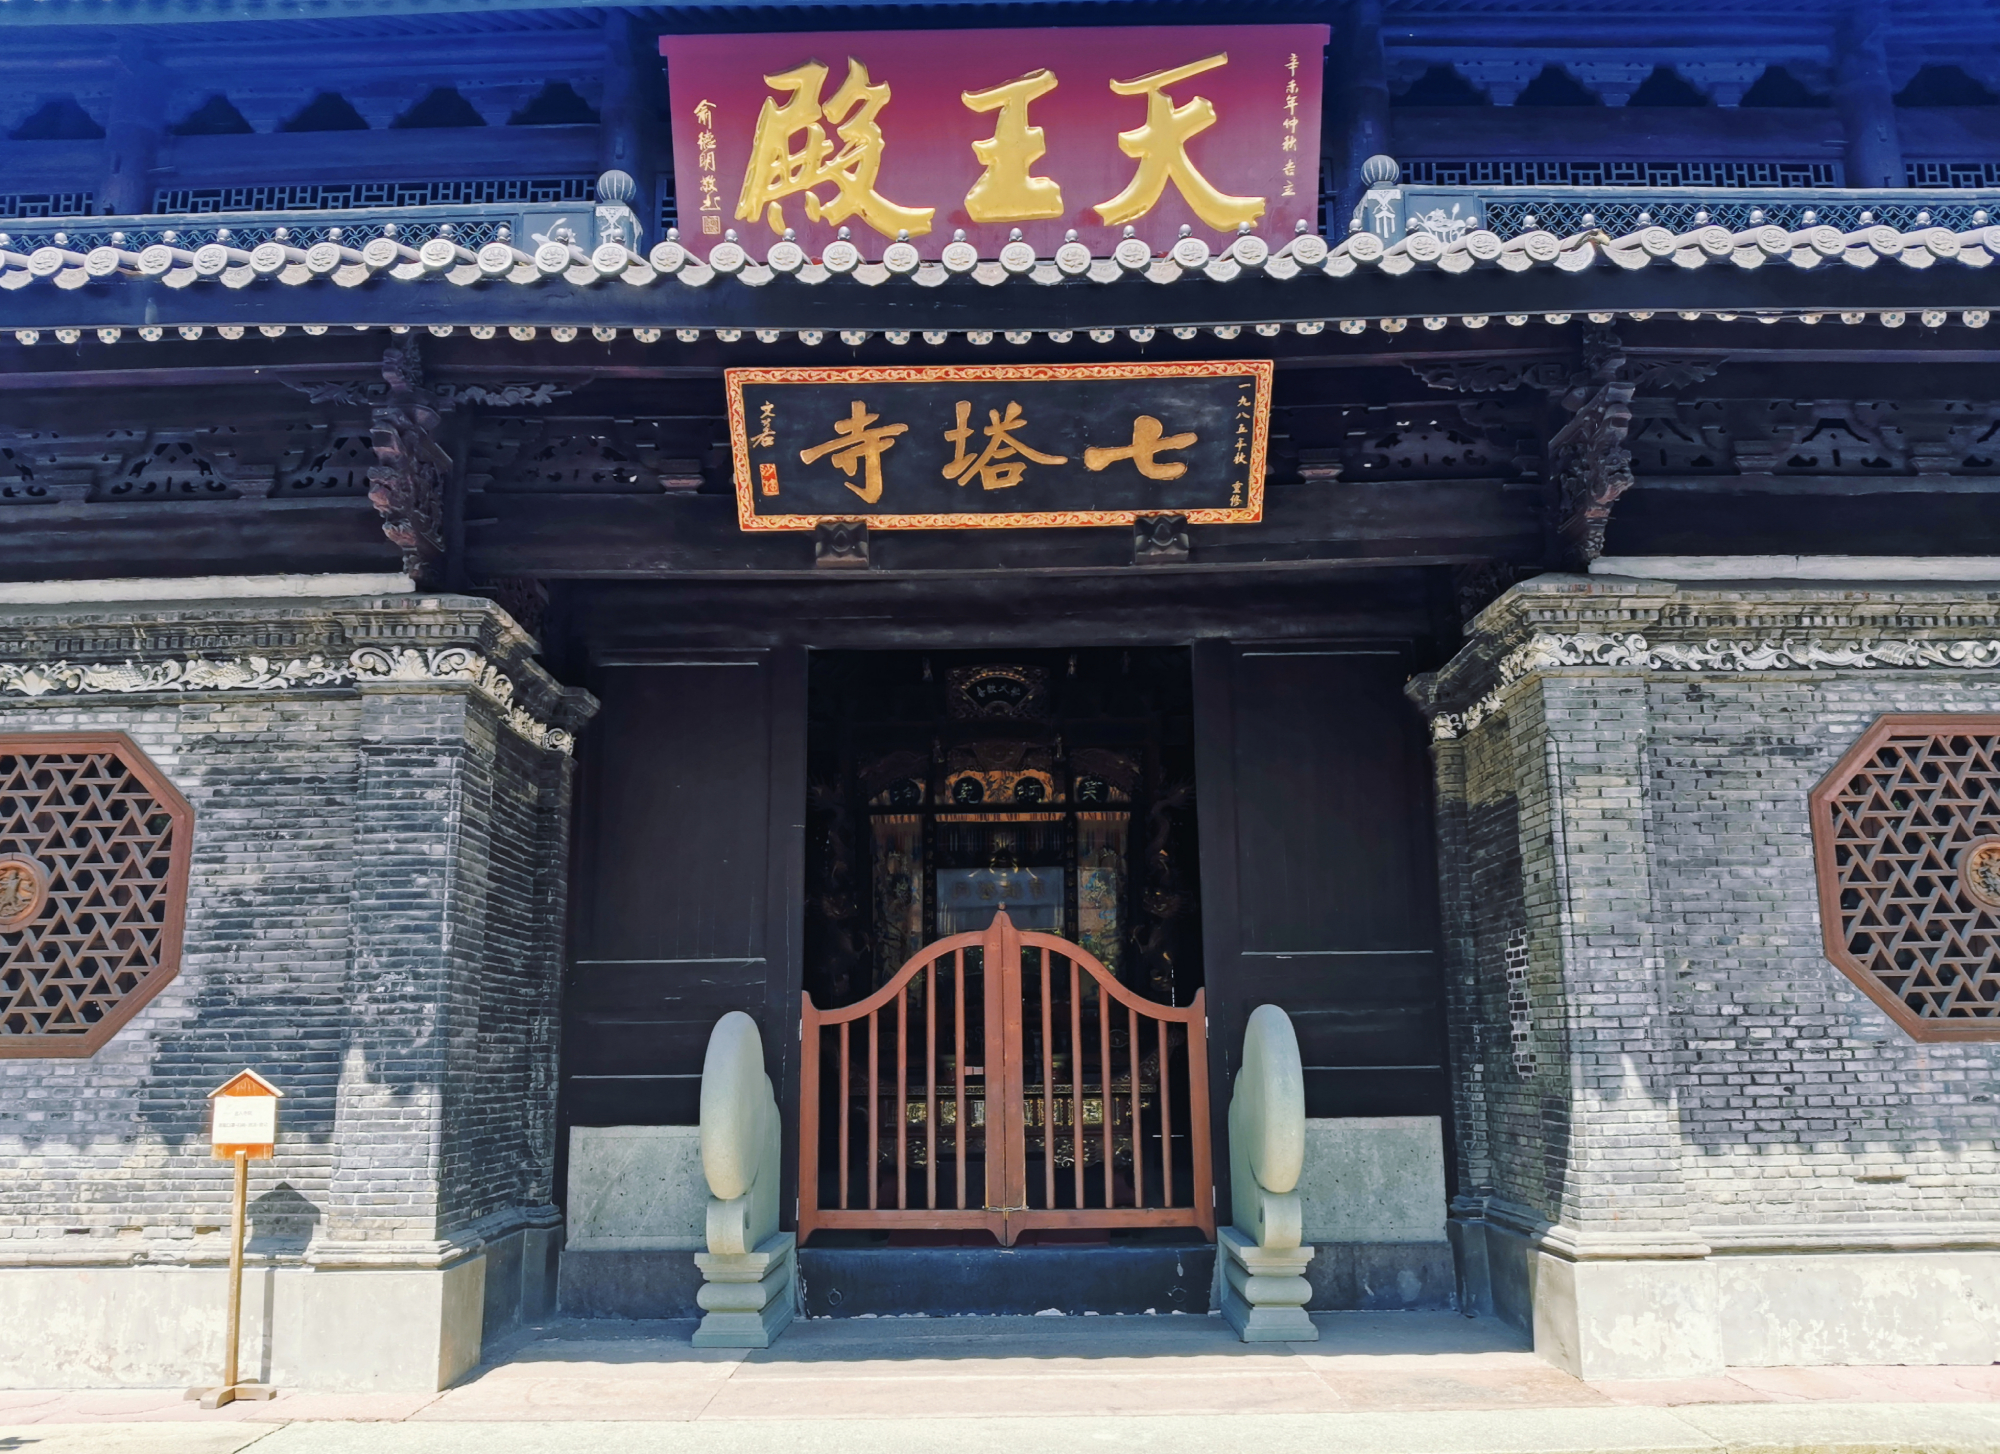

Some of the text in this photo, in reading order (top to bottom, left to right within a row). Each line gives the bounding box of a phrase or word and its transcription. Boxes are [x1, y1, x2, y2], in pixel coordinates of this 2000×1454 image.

[734, 52, 1266, 238] 天王殿
[800, 400, 1198, 504] 七塔寺
